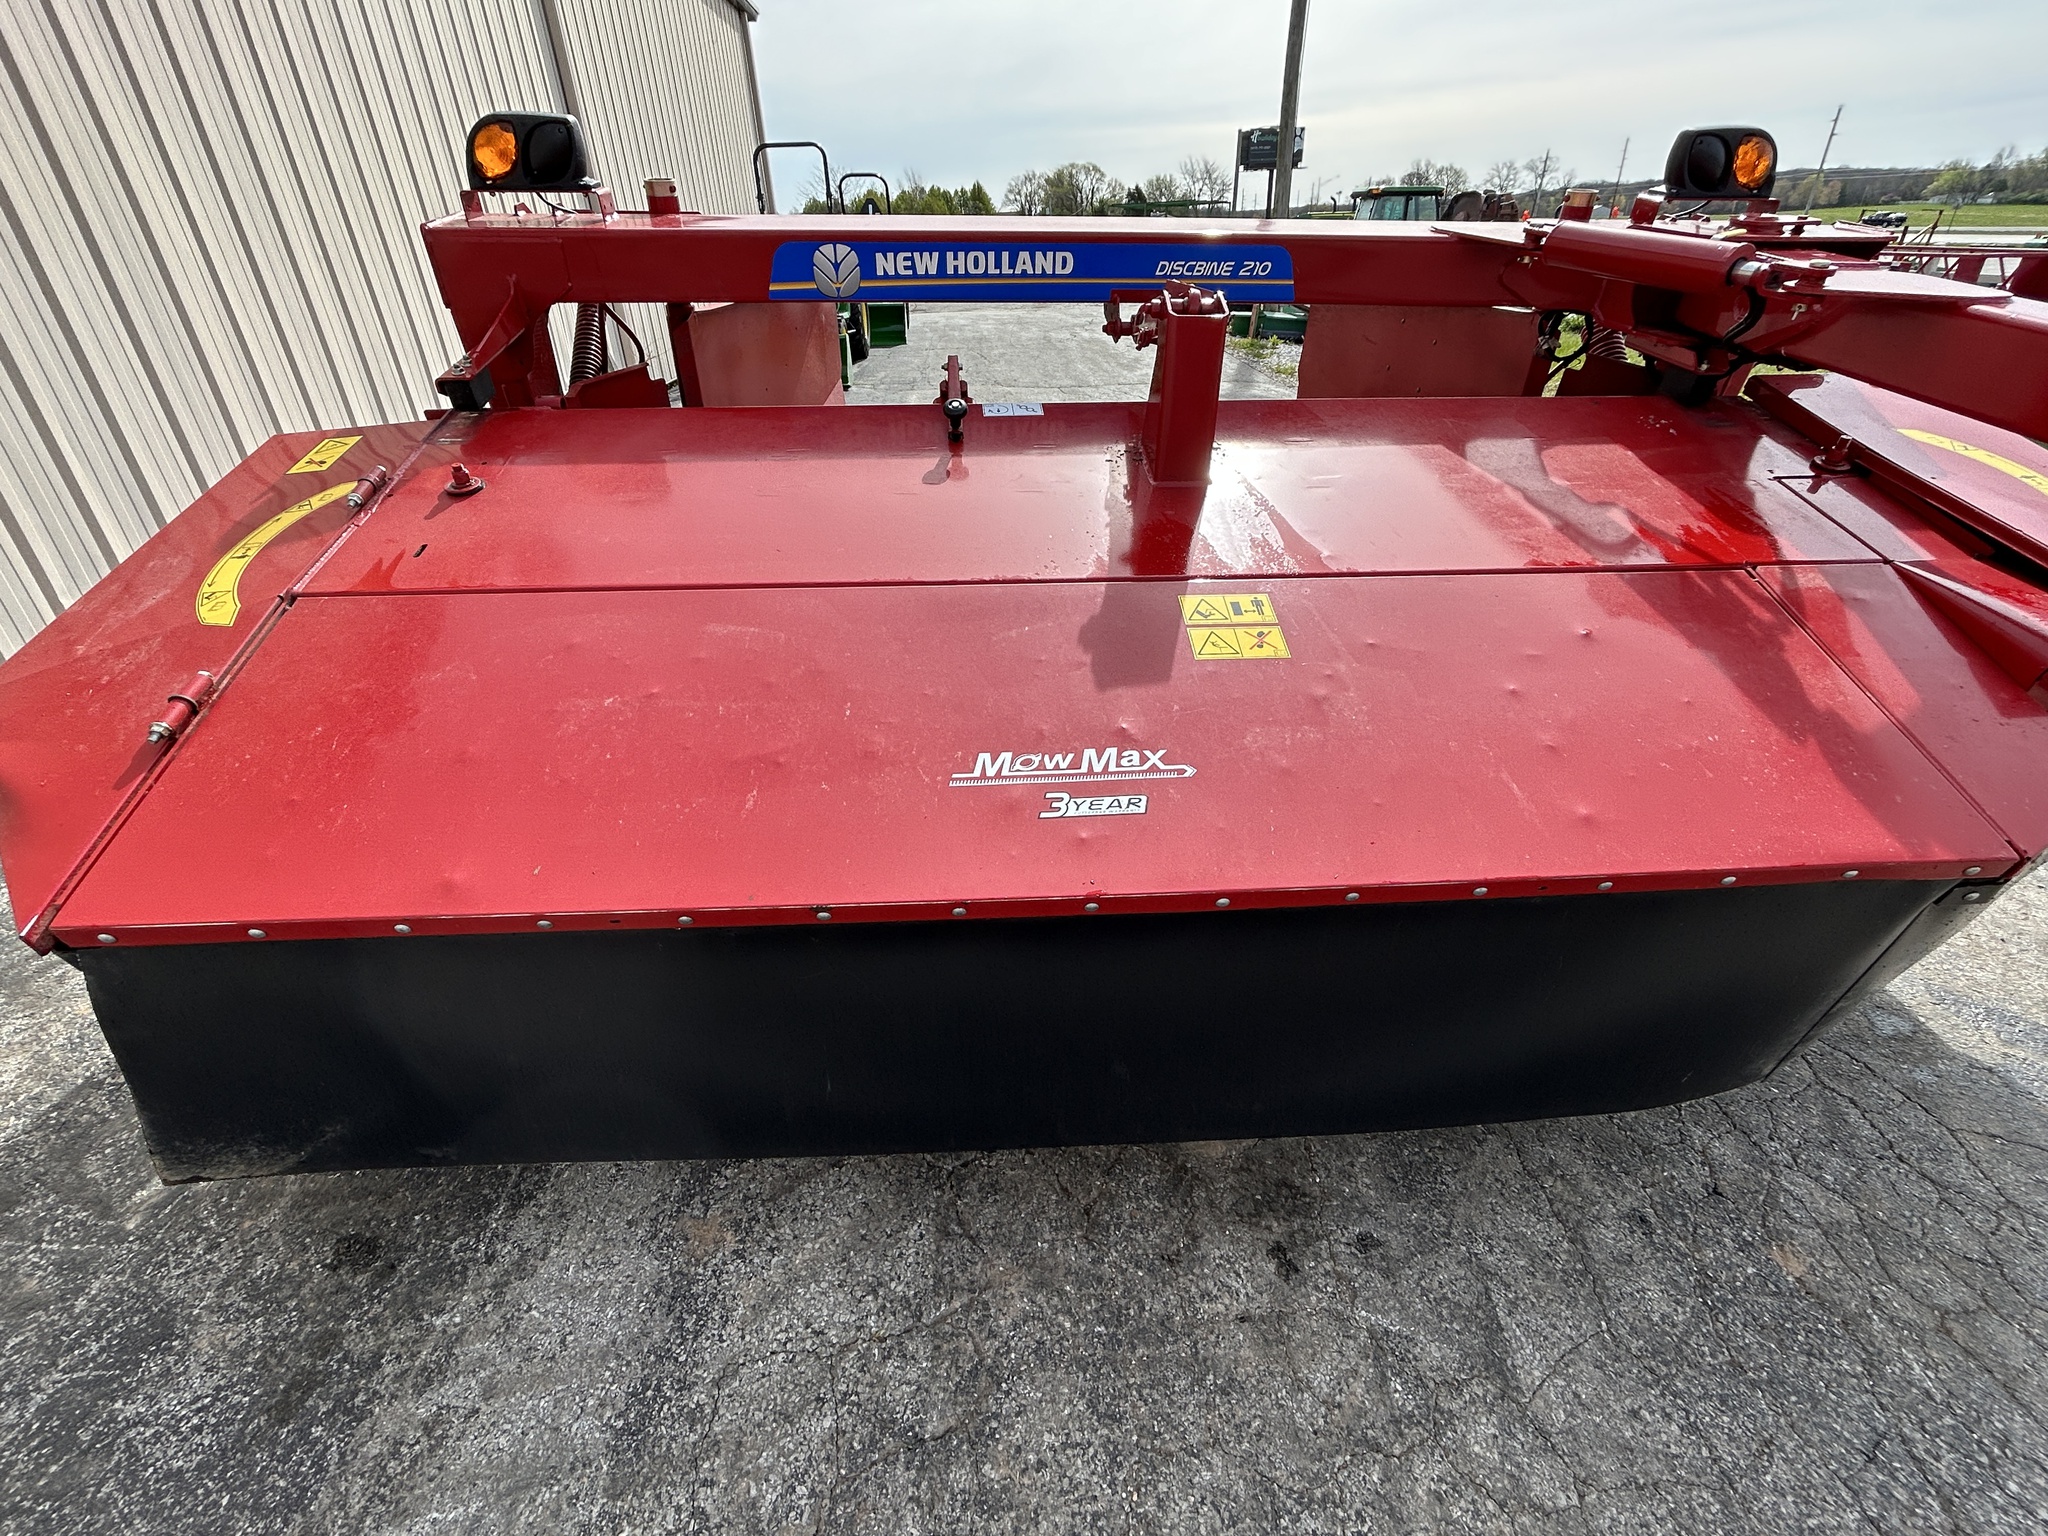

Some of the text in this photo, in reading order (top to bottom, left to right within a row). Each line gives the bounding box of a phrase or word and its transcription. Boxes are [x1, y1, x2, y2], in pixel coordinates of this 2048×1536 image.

[875, 251, 1074, 275] NEW HOLLAND
[1155, 261, 1272, 276] DISCBINE 210
